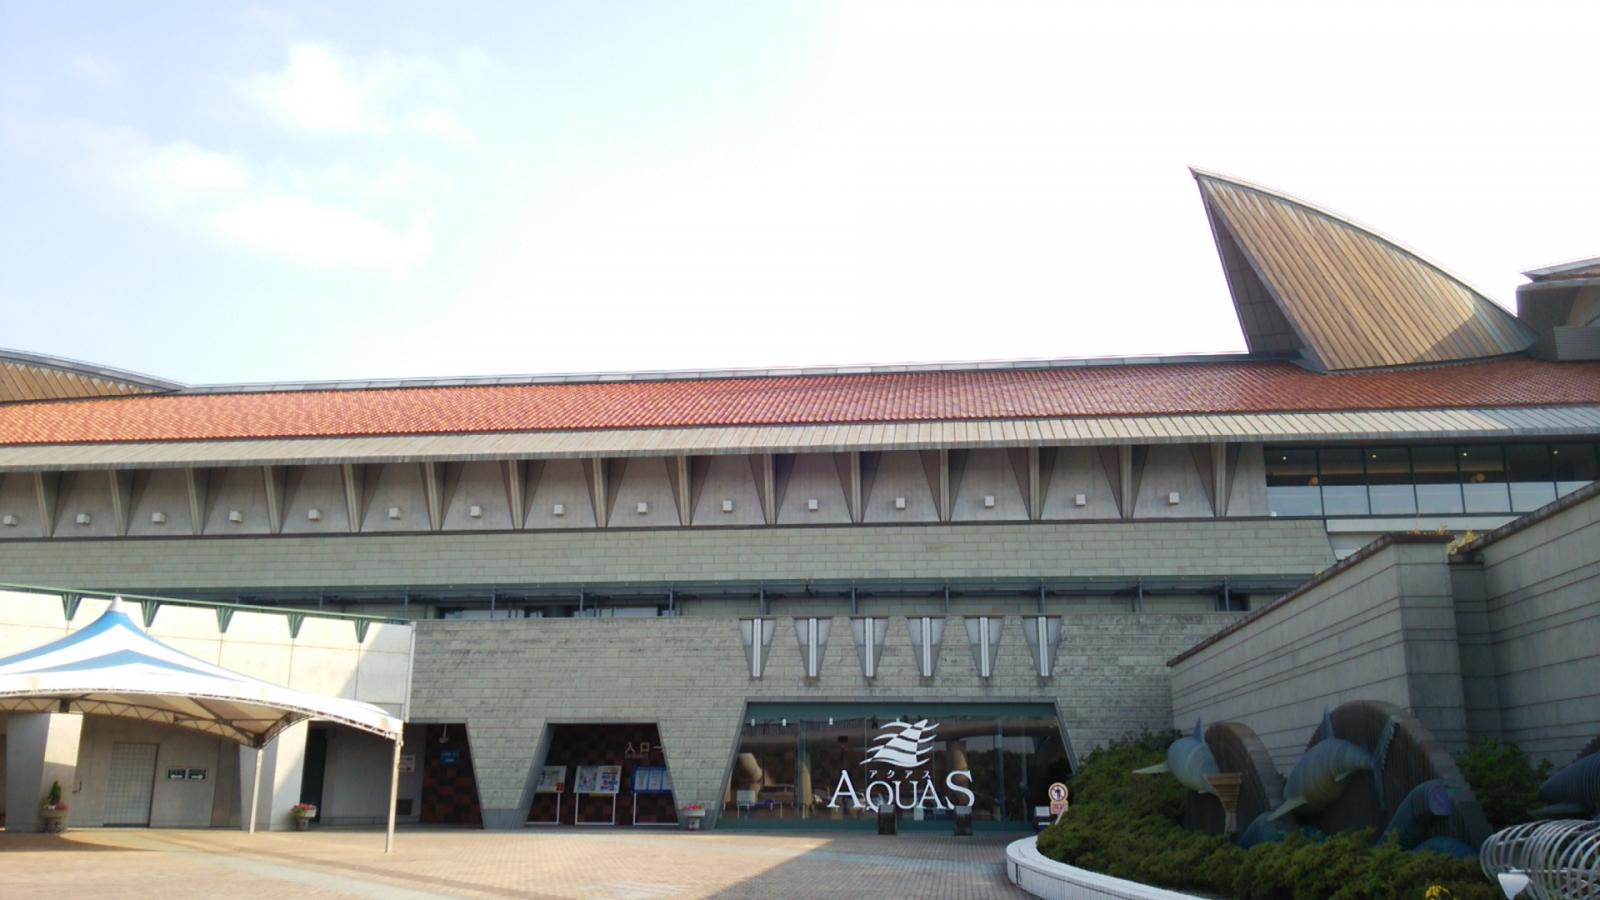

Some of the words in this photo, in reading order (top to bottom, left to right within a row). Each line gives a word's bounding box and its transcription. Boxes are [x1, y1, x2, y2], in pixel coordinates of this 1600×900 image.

[869, 769, 931, 779] アクアス
[827, 769, 975, 813] AQUAS
